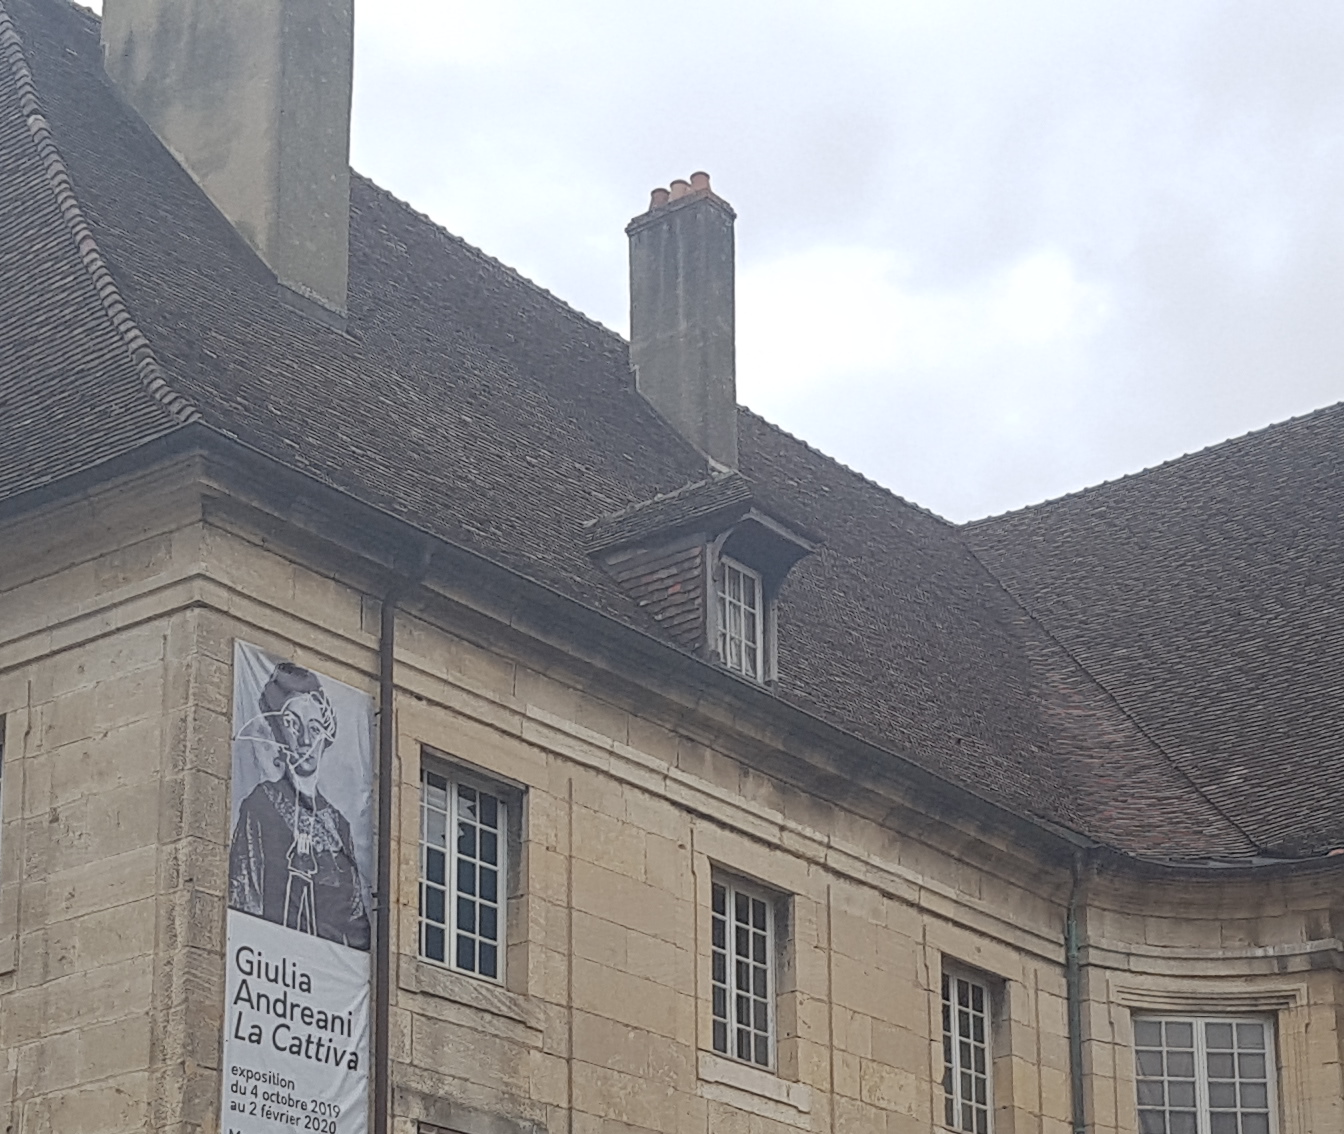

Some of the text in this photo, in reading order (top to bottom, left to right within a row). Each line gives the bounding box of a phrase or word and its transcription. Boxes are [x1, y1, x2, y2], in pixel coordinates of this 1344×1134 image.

[235, 945, 312, 994] Giulia
[233, 978, 353, 1038] Andreani
[234, 1010, 359, 1071] La Cattiva
[231, 1065, 296, 1091] exposition
[230, 1081, 341, 1119] du 4 octobre 2019
[230, 1100, 337, 1134] au 2 février 2020
